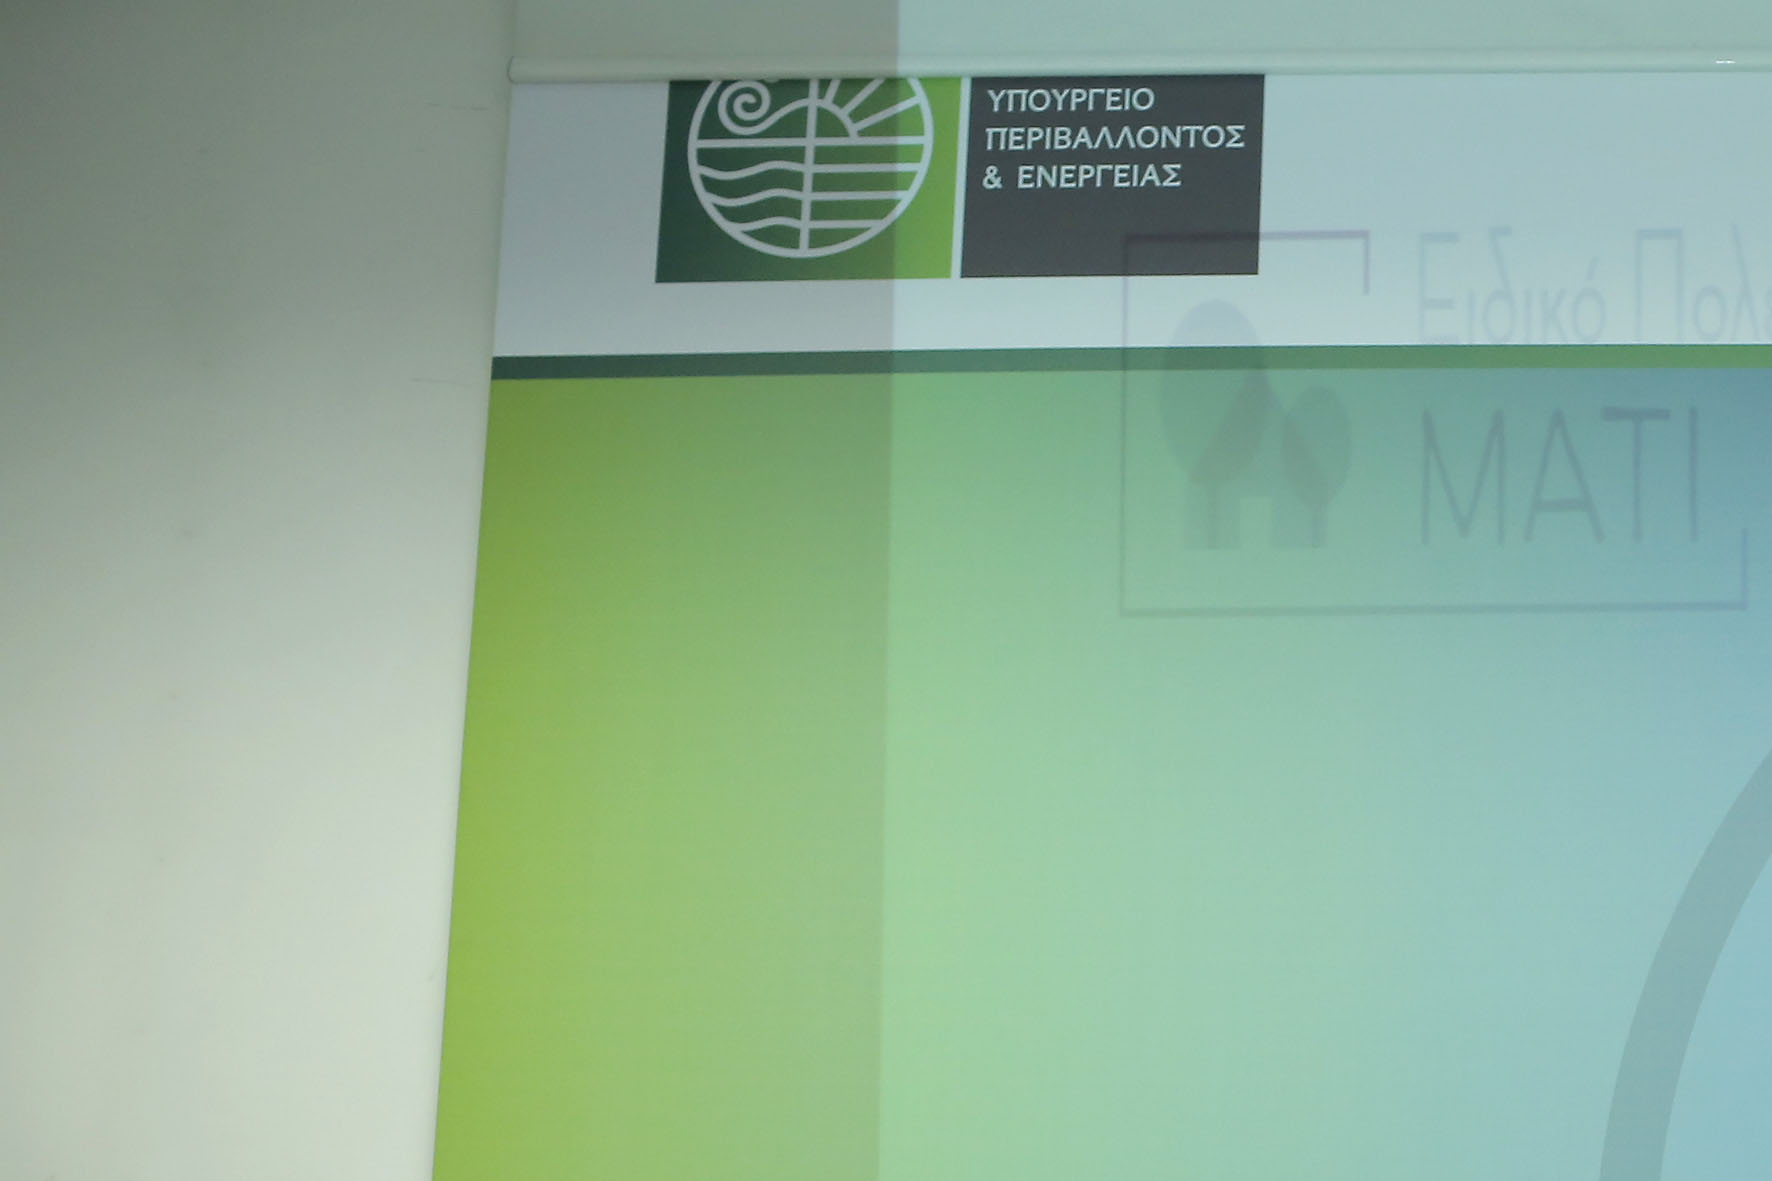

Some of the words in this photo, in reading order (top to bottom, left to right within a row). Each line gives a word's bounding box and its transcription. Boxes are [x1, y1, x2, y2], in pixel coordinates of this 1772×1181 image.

[987, 87, 1155, 114] ΥΠΟΥΡΓΕΙΟ
[985, 125, 1246, 152] ΠΕΡΙΒΑΛΛΟΝΤΟΣ
[982, 164, 1003, 190] &
[1017, 163, 1182, 189] ΕΝΕΡΓΕΙΑΣ
[1418, 225, 1607, 345] Ειδικό
[1420, 407, 1699, 545] ΜΑΤΙ
